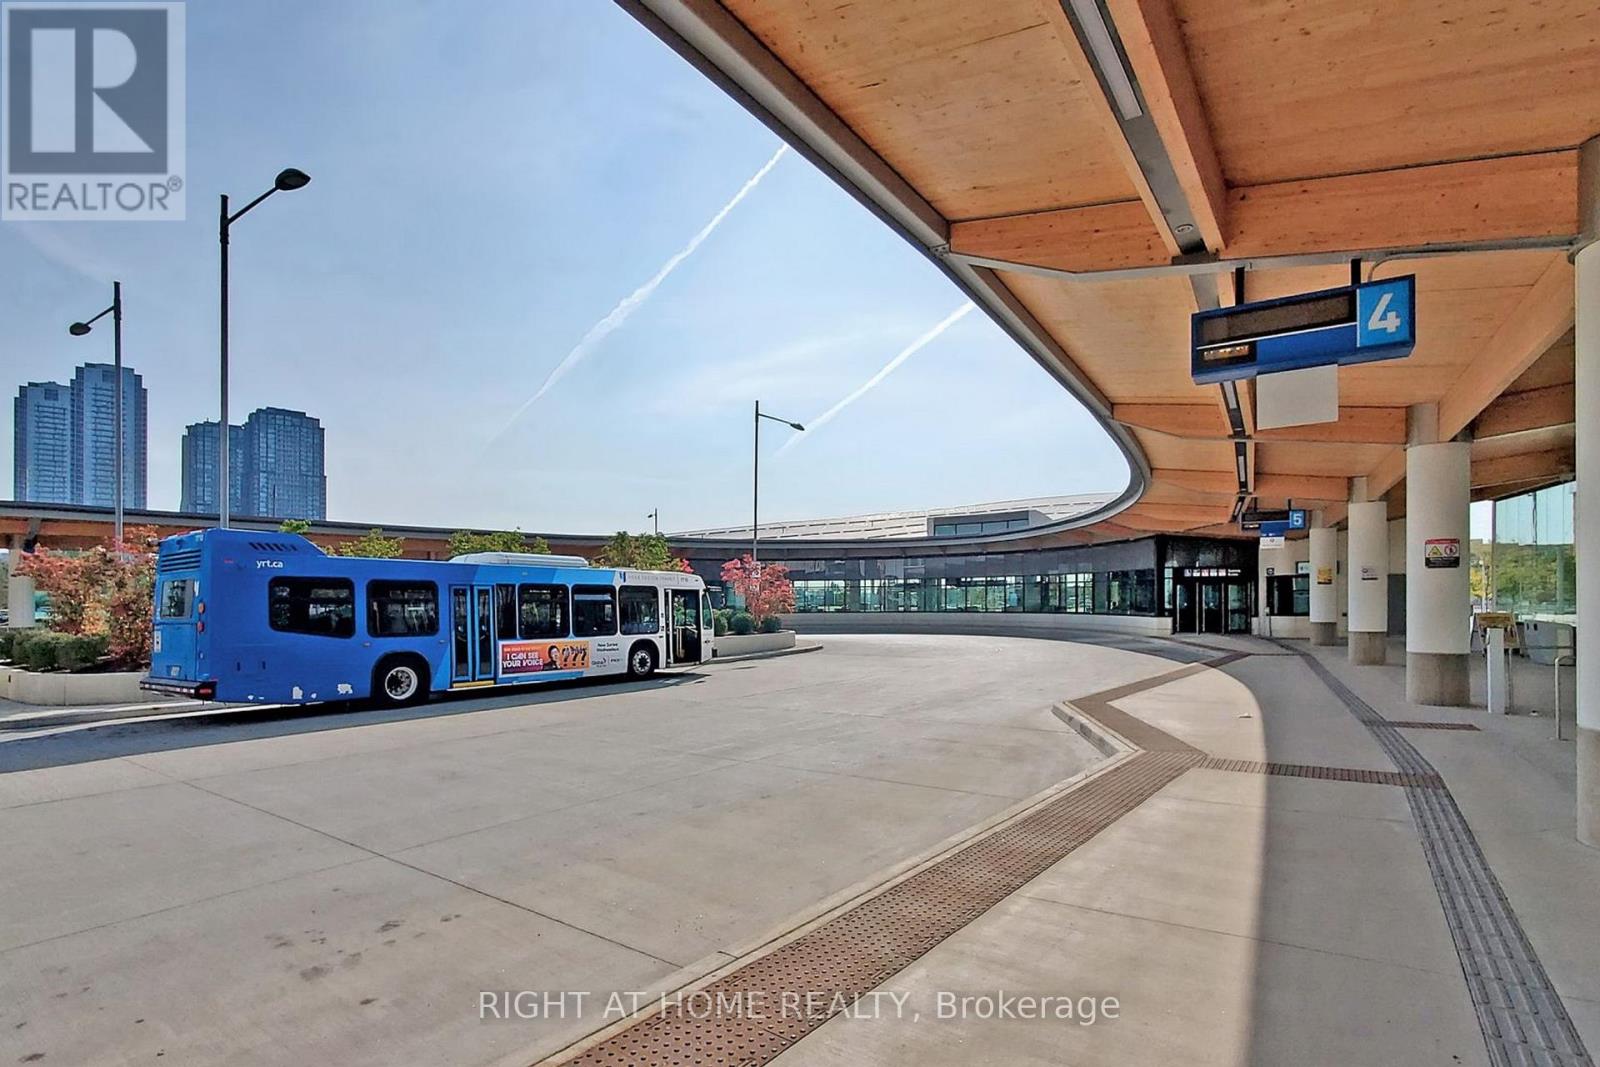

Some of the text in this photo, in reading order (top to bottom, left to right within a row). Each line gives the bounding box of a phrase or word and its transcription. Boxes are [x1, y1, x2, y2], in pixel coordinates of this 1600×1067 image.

[1368, 292, 1401, 333] 4
[1293, 513, 1302, 525] 5
[256, 559, 284, 569] yrt.ca
[511, 652, 527, 660] CAN
[528, 651, 539, 659] SEE
[502, 658, 544, 668] YOUR VOICE
